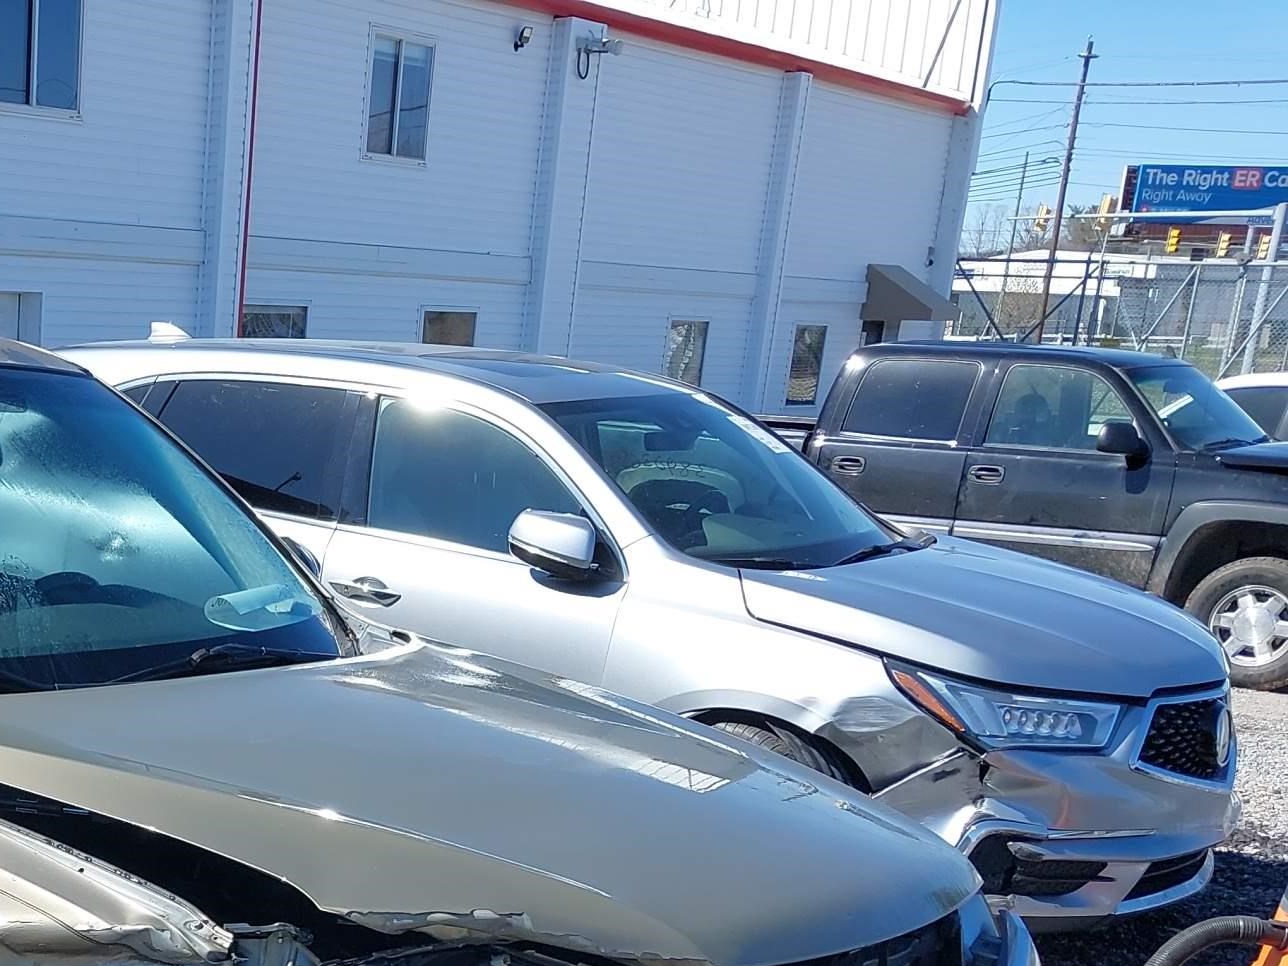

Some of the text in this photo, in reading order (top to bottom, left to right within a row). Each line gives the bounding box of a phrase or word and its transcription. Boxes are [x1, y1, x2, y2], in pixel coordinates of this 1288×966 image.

[1145, 168, 1178, 186] The
[1183, 169, 1229, 190] Right
[1234, 170, 1260, 188] ER
[1141, 189, 1212, 204] Right Away
